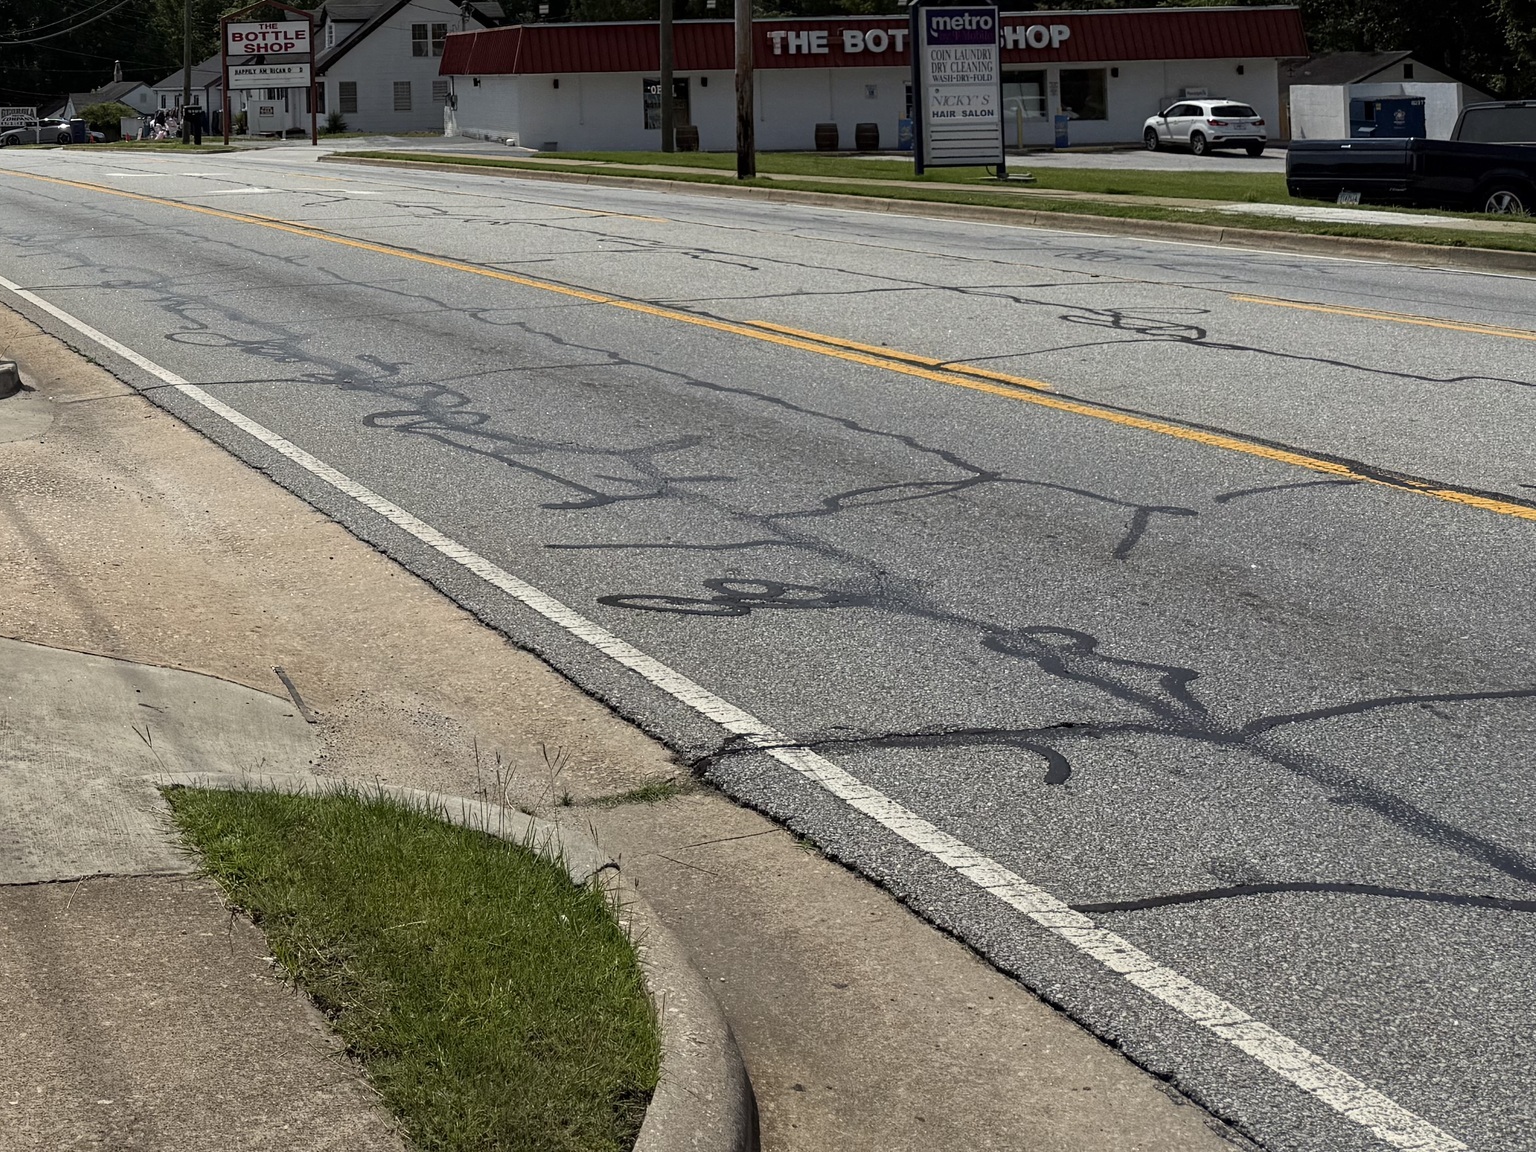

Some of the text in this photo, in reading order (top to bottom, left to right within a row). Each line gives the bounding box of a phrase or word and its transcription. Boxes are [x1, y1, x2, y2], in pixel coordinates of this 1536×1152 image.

[932, 12, 992, 30] metro
[231, 30, 306, 42] BOTTLE
[767, 24, 1071, 55] THE BOT HOP
[244, 42, 295, 54] SHOP
[931, 48, 992, 61] COIN LAUNDRY
[931, 61, 993, 74] DRY CLEANING
[932, 109, 994, 118] HAIR SALON
